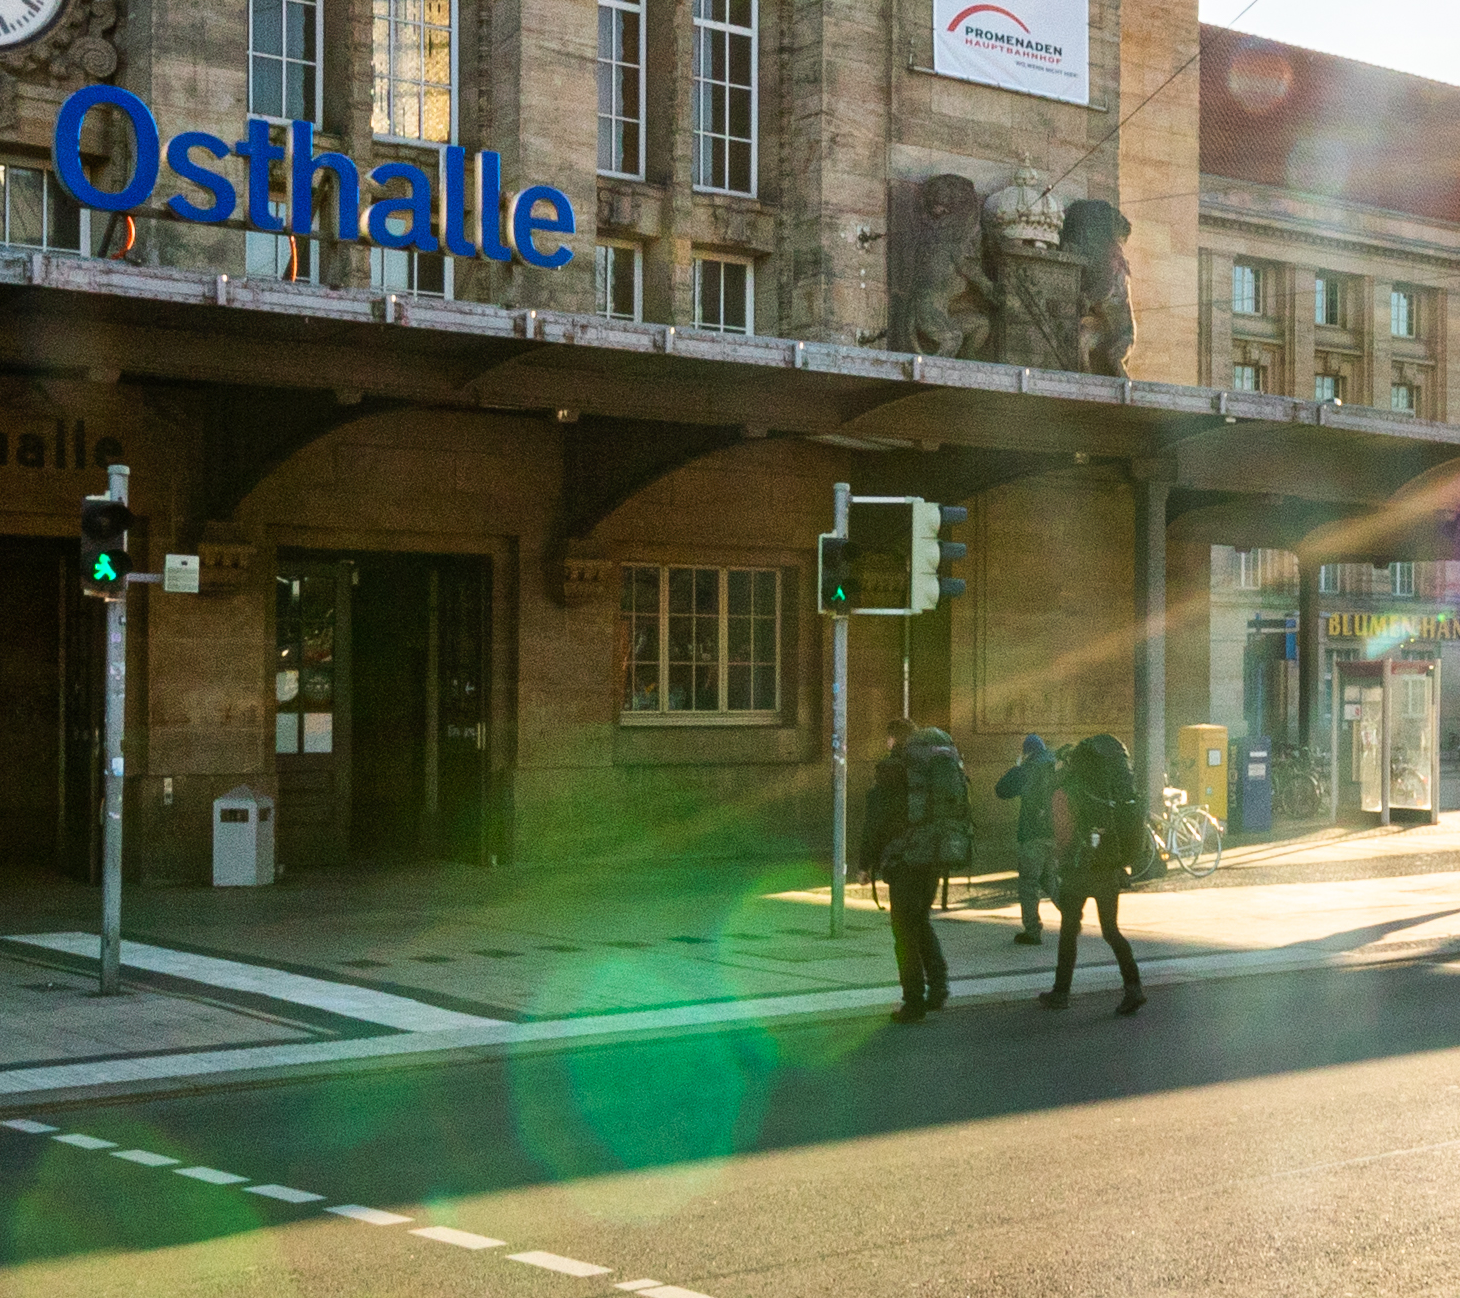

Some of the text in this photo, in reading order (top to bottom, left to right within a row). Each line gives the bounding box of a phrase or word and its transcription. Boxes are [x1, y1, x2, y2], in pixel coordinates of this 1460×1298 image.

[965, 26, 1062, 56] PROMENADEN
[965, 38, 1062, 64] HAUPTBAHNHOF
[54, 85, 576, 268] Osthalle
[1328, 613, 1417, 637] BLUMEN
